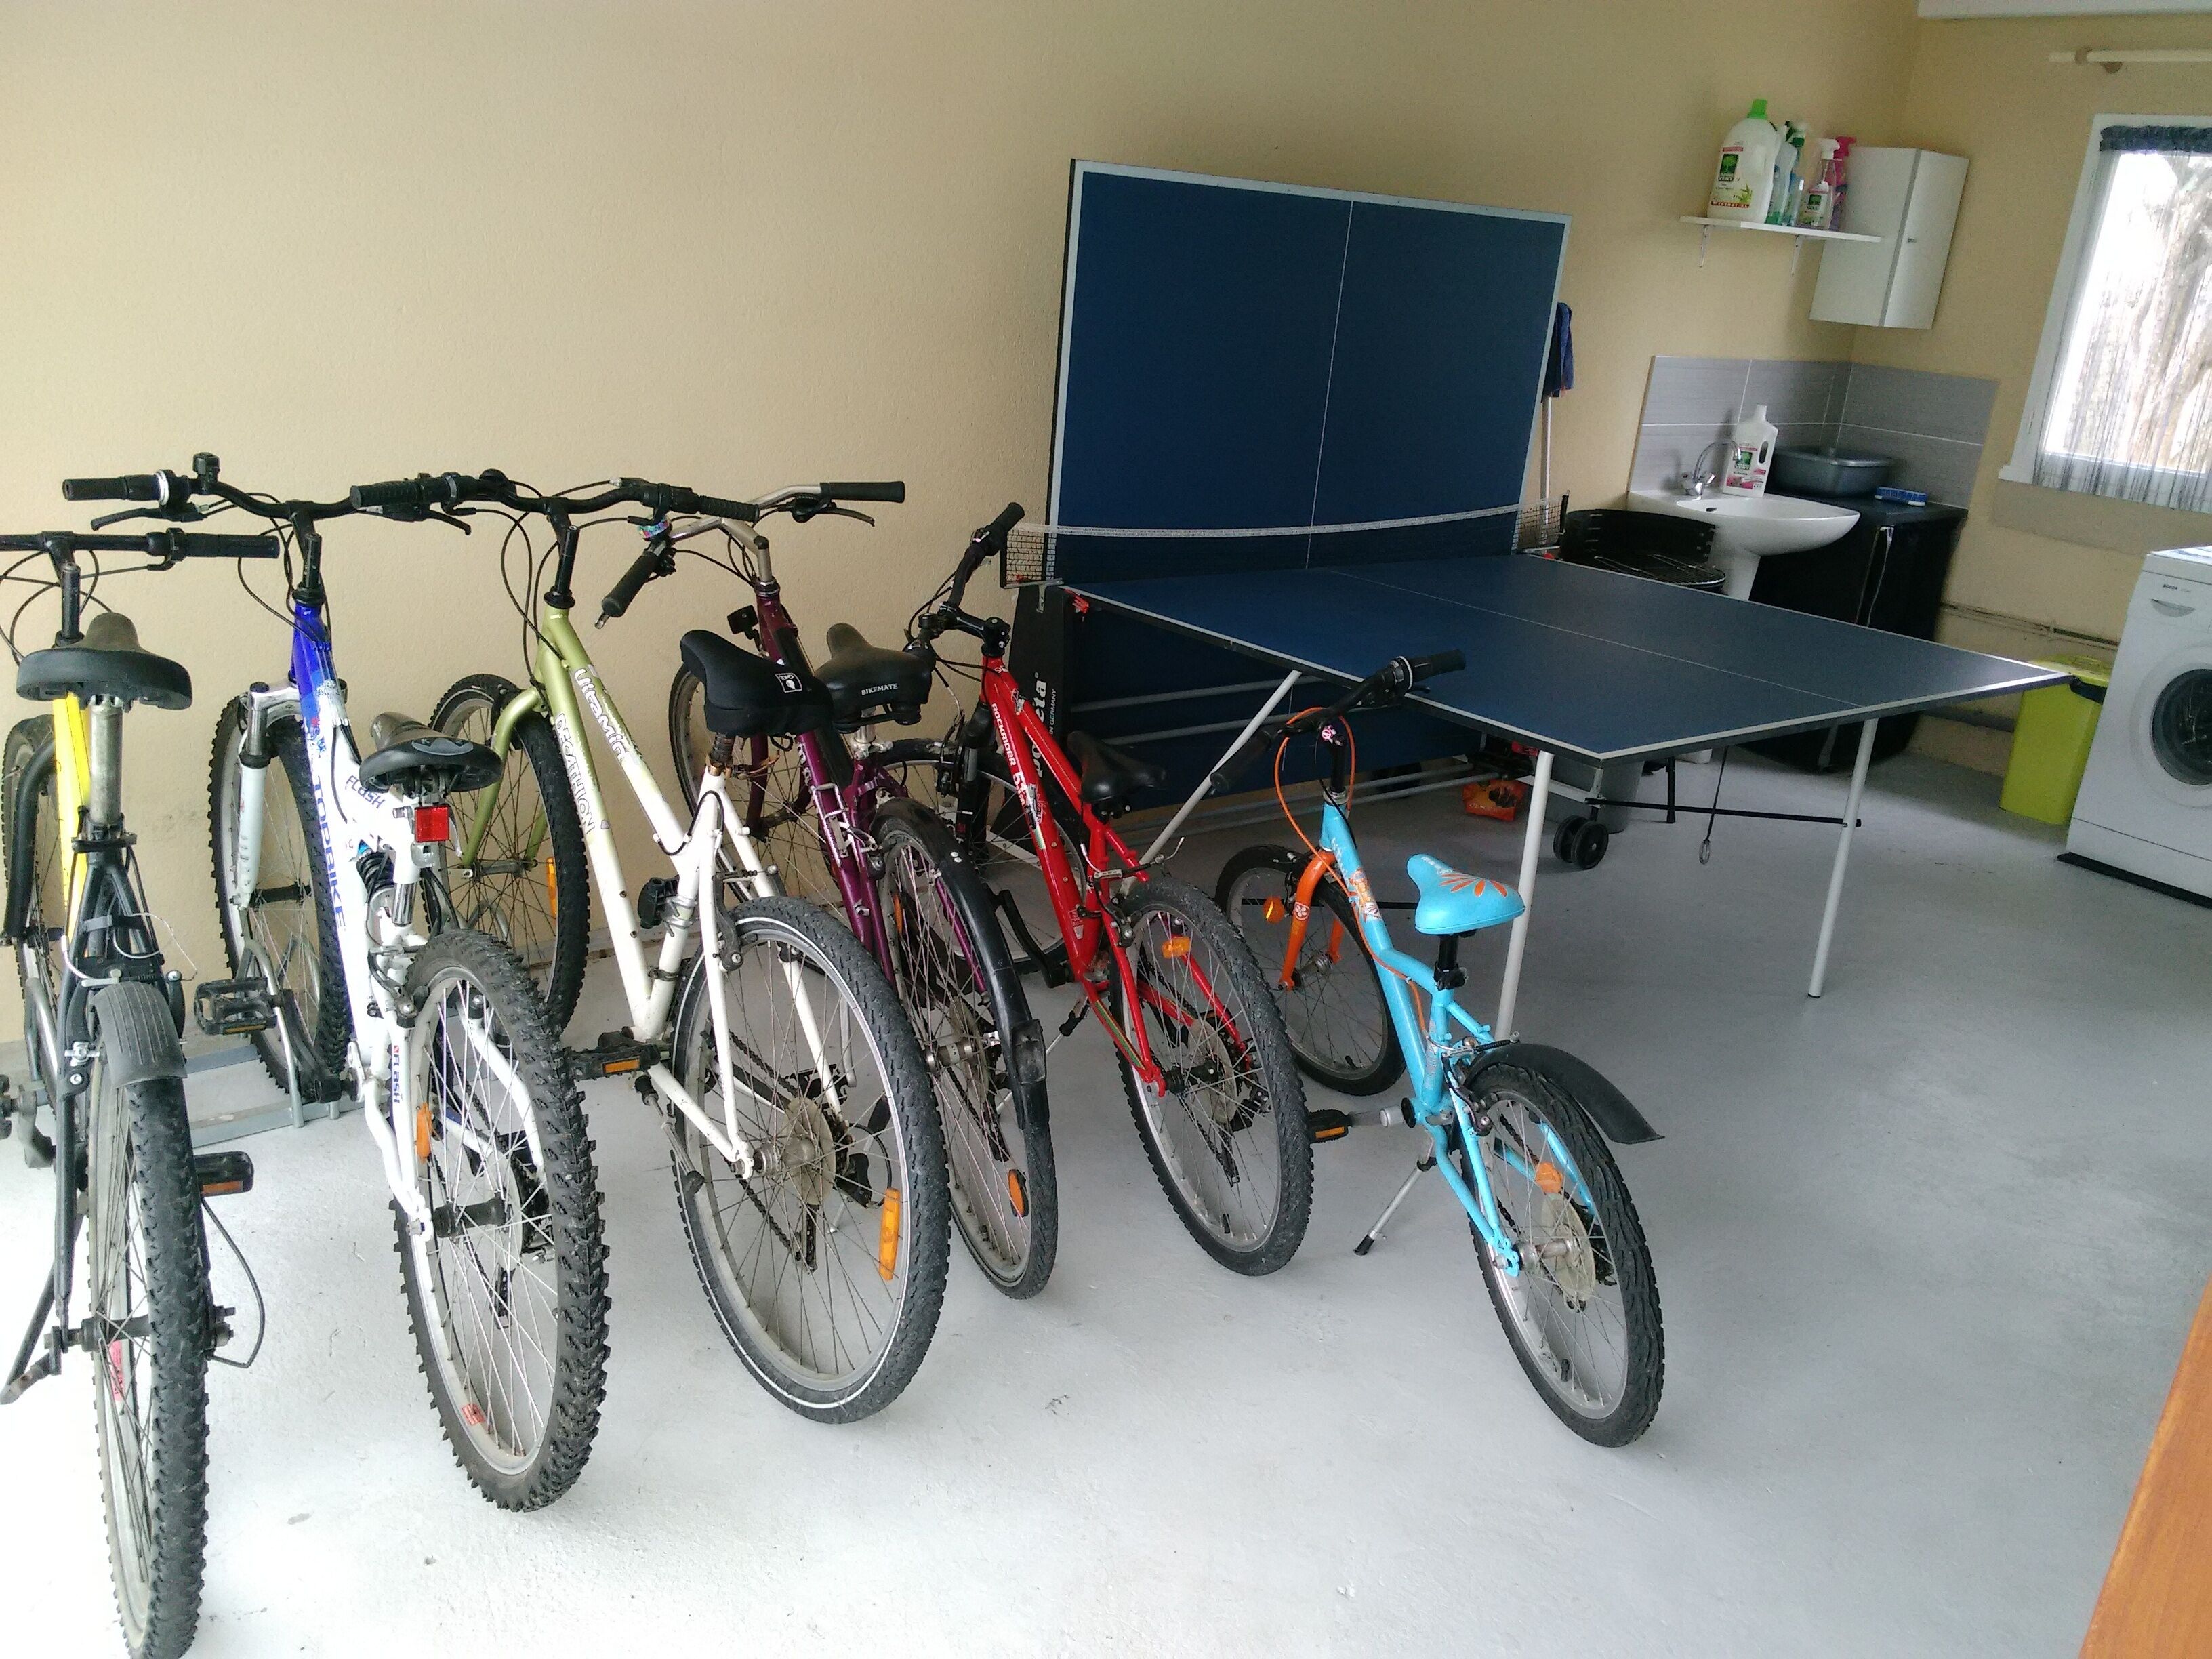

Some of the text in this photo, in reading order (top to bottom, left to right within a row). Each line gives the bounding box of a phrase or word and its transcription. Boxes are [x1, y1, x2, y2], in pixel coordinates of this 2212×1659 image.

[861, 682, 898, 696] BIKEMATE
[1049, 688, 1057, 726] GERMANY
[991, 703, 1016, 767] ROCKRIDER
[554, 712, 596, 835] DECATHLON
